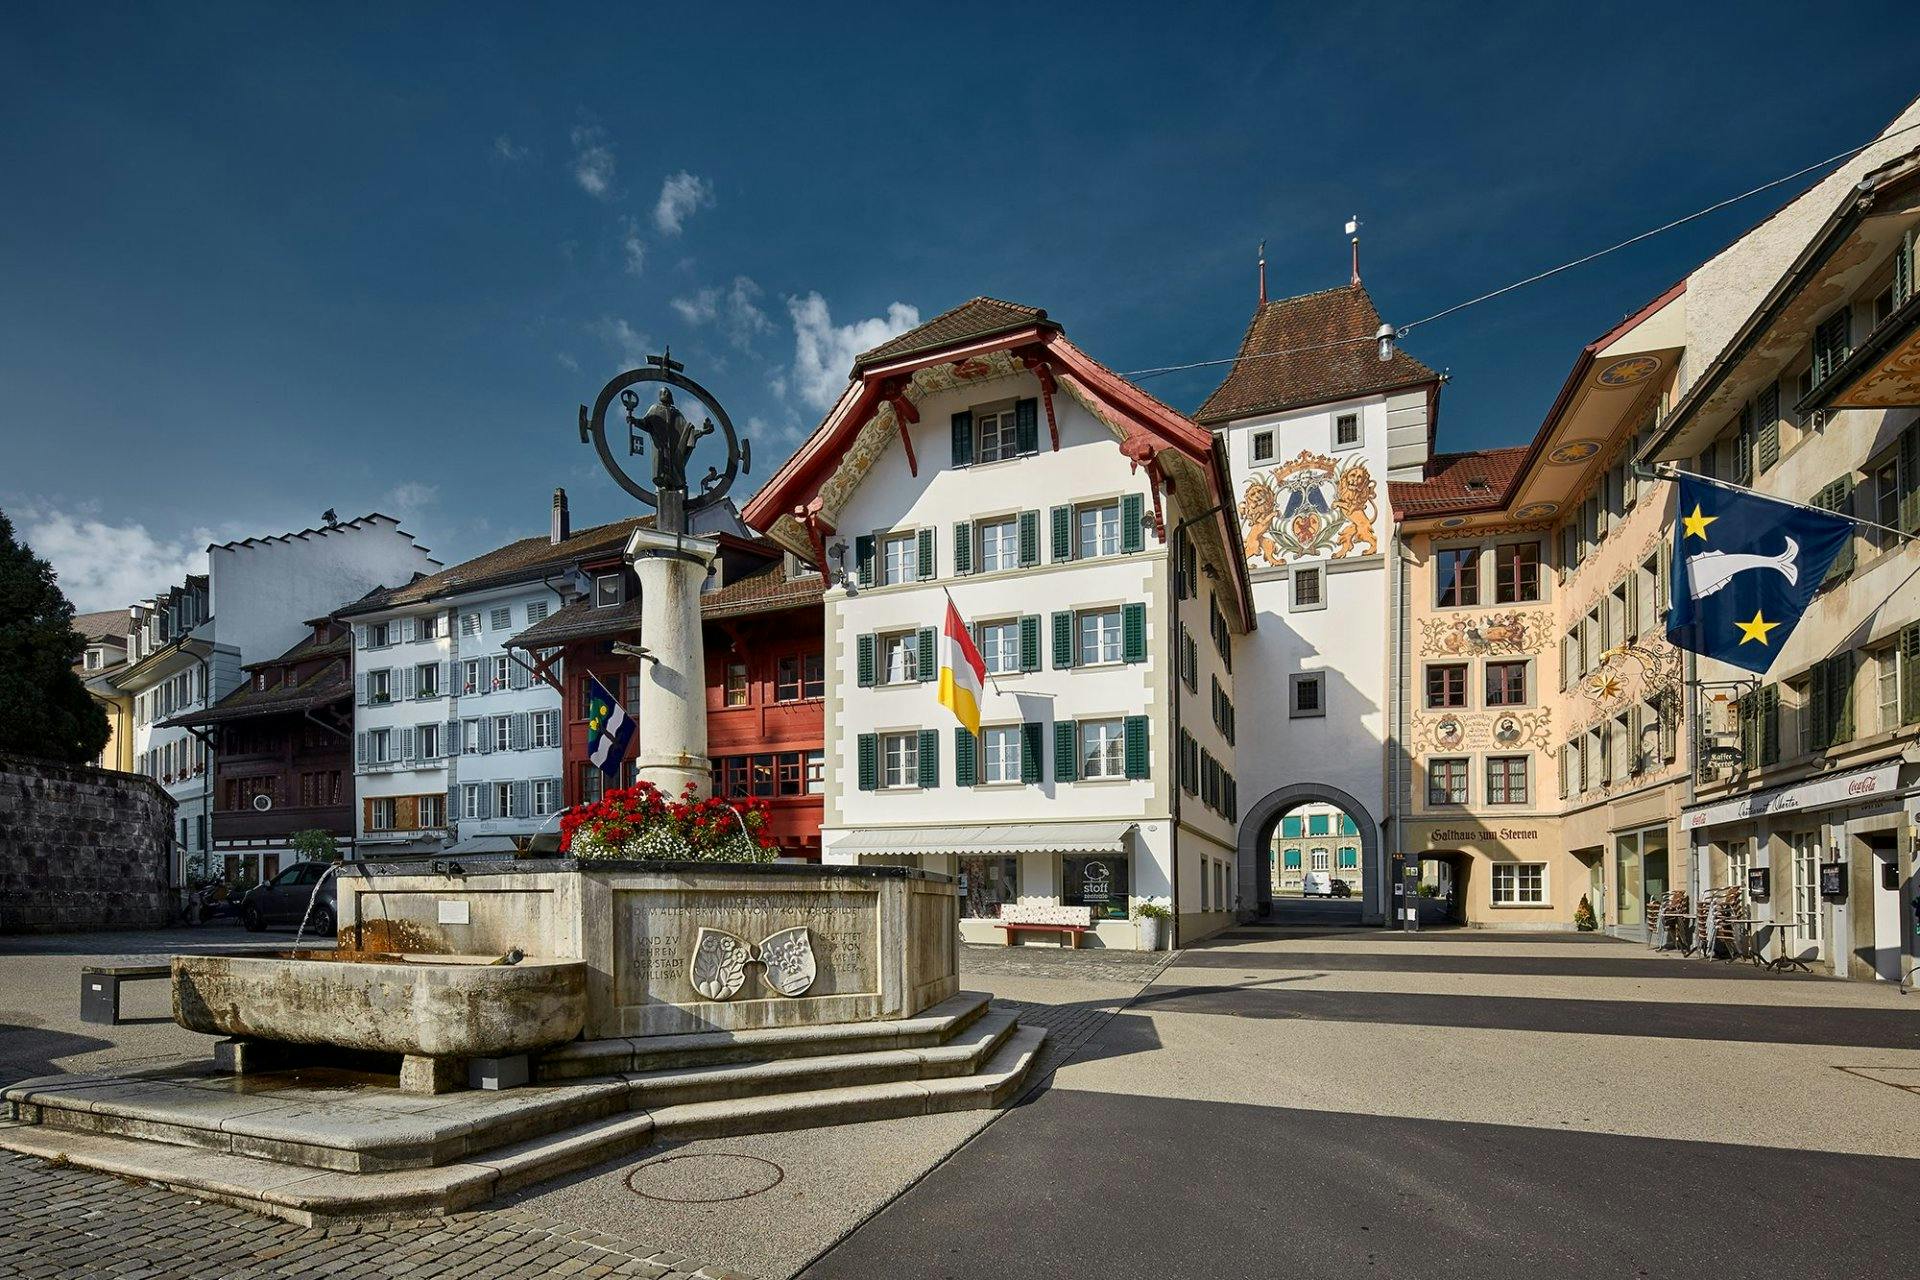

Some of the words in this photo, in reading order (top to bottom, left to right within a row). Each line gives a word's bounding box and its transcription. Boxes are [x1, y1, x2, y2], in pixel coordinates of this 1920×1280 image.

[1848, 776, 1877, 795] Coca-Cola
[1479, 830, 1498, 841] zum
[1500, 828, 1538, 840] Sternen
[1083, 882, 1108, 893] stoff
[640, 947, 677, 956] EHREN
